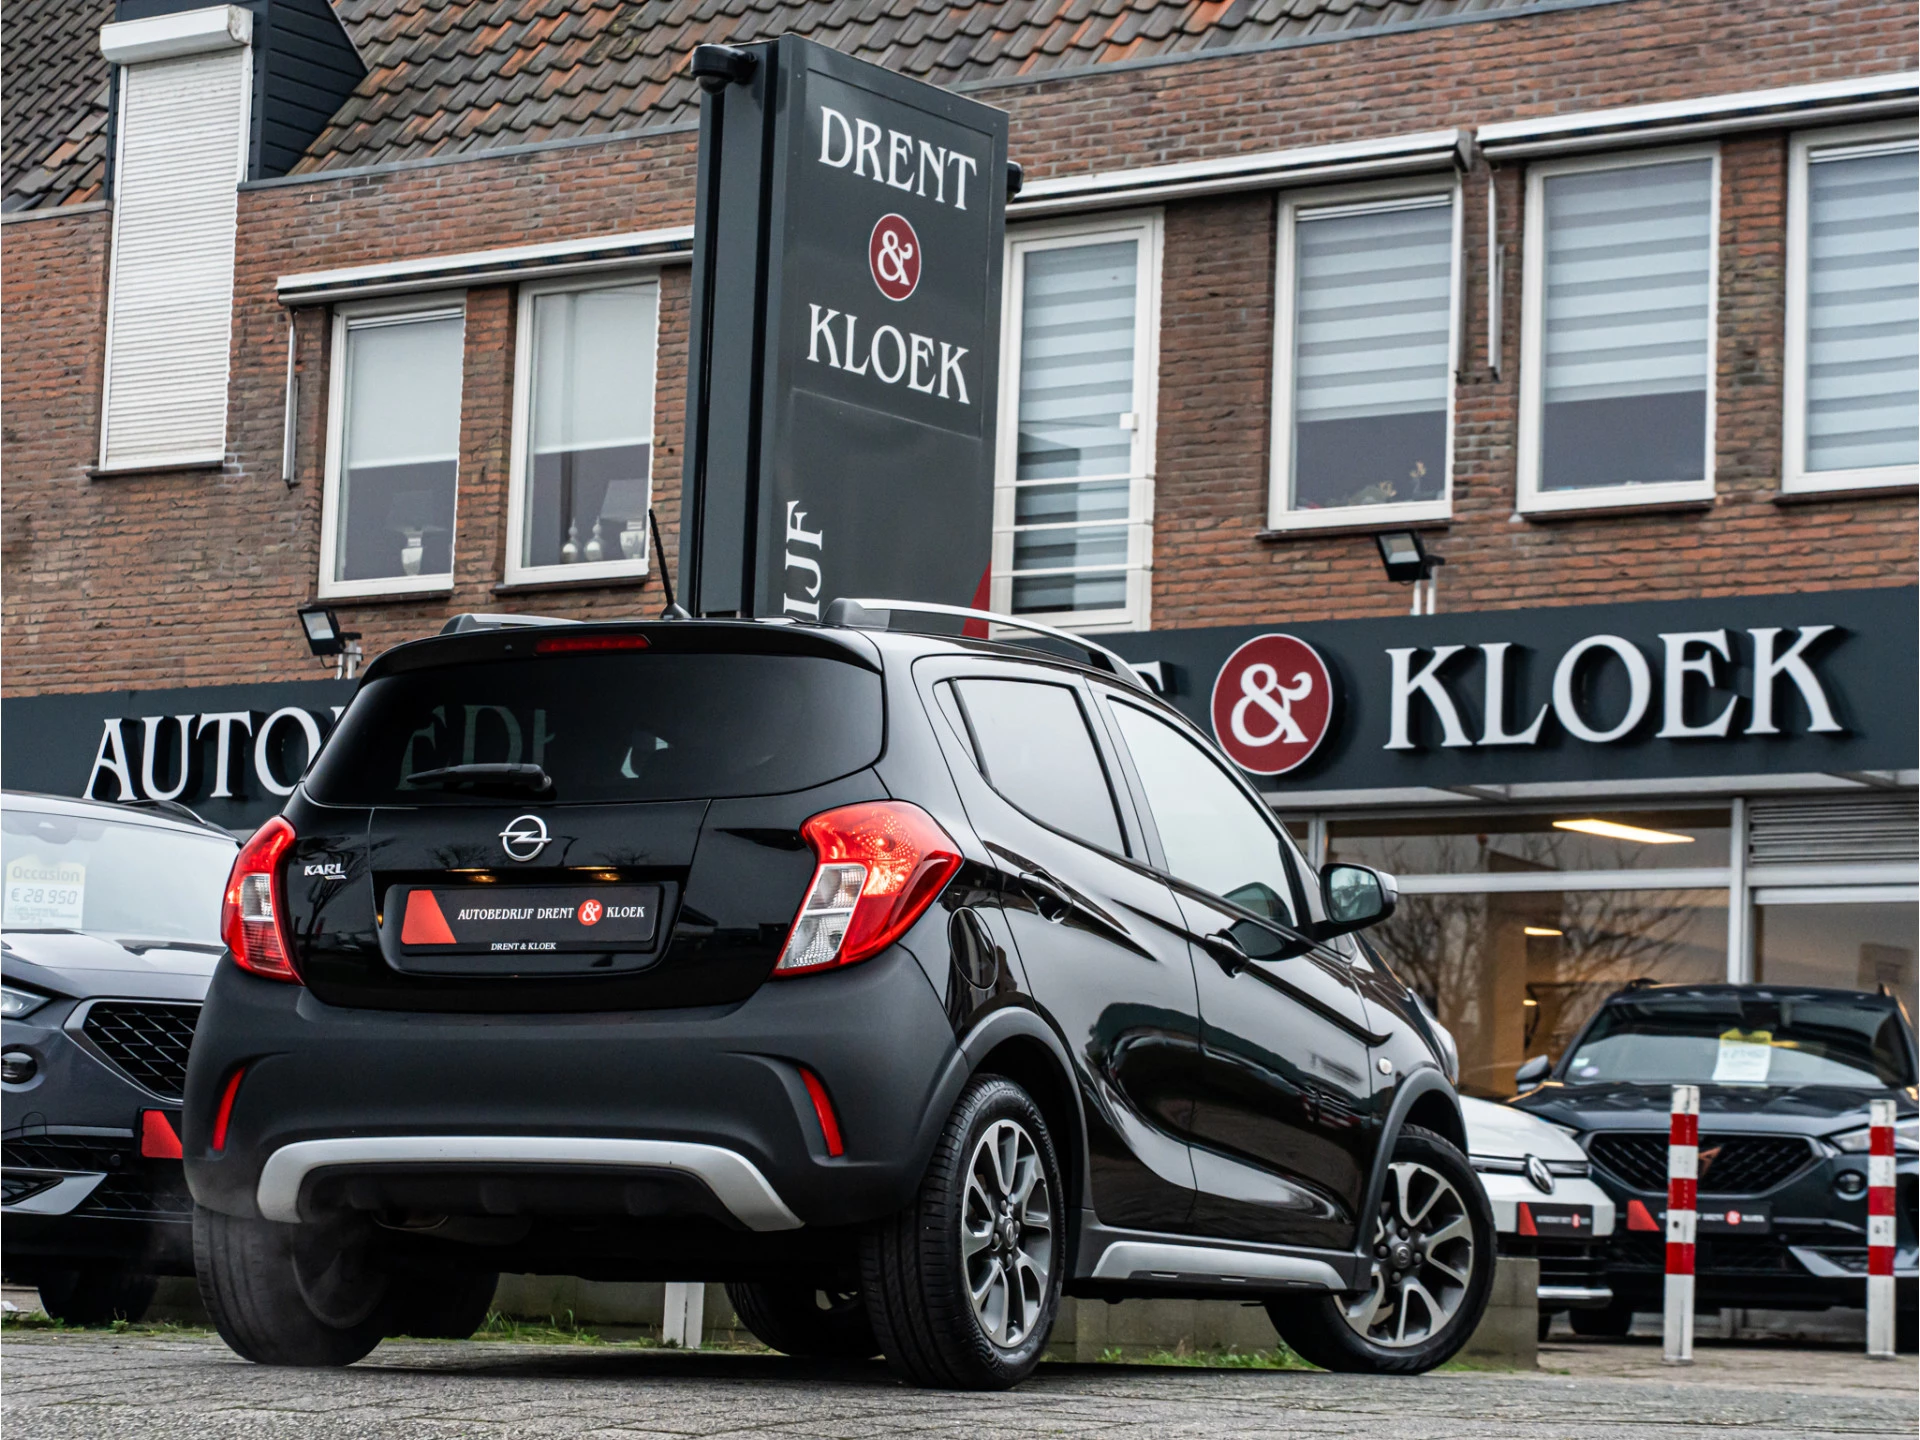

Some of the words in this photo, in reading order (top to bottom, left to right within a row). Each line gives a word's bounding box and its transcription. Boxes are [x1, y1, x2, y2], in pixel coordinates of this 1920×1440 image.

[817, 105, 977, 211] DRENT
[877, 230, 913, 286] &
[806, 302, 971, 405] KLOEK
[1230, 662, 1313, 748] &
[1382, 624, 1845, 750] KLOEK
[12, 865, 80, 882] Occasion
[303, 862, 346, 876] KARL
[457, 908, 535, 920] AUTOBEDRIJF
[537, 907, 575, 919] DRENT
[582, 901, 601, 922] &
[606, 906, 646, 918] KLOEK
[491, 942, 519, 951] DRENT
[520, 942, 527, 950] &
[528, 942, 557, 950] KLOEK
